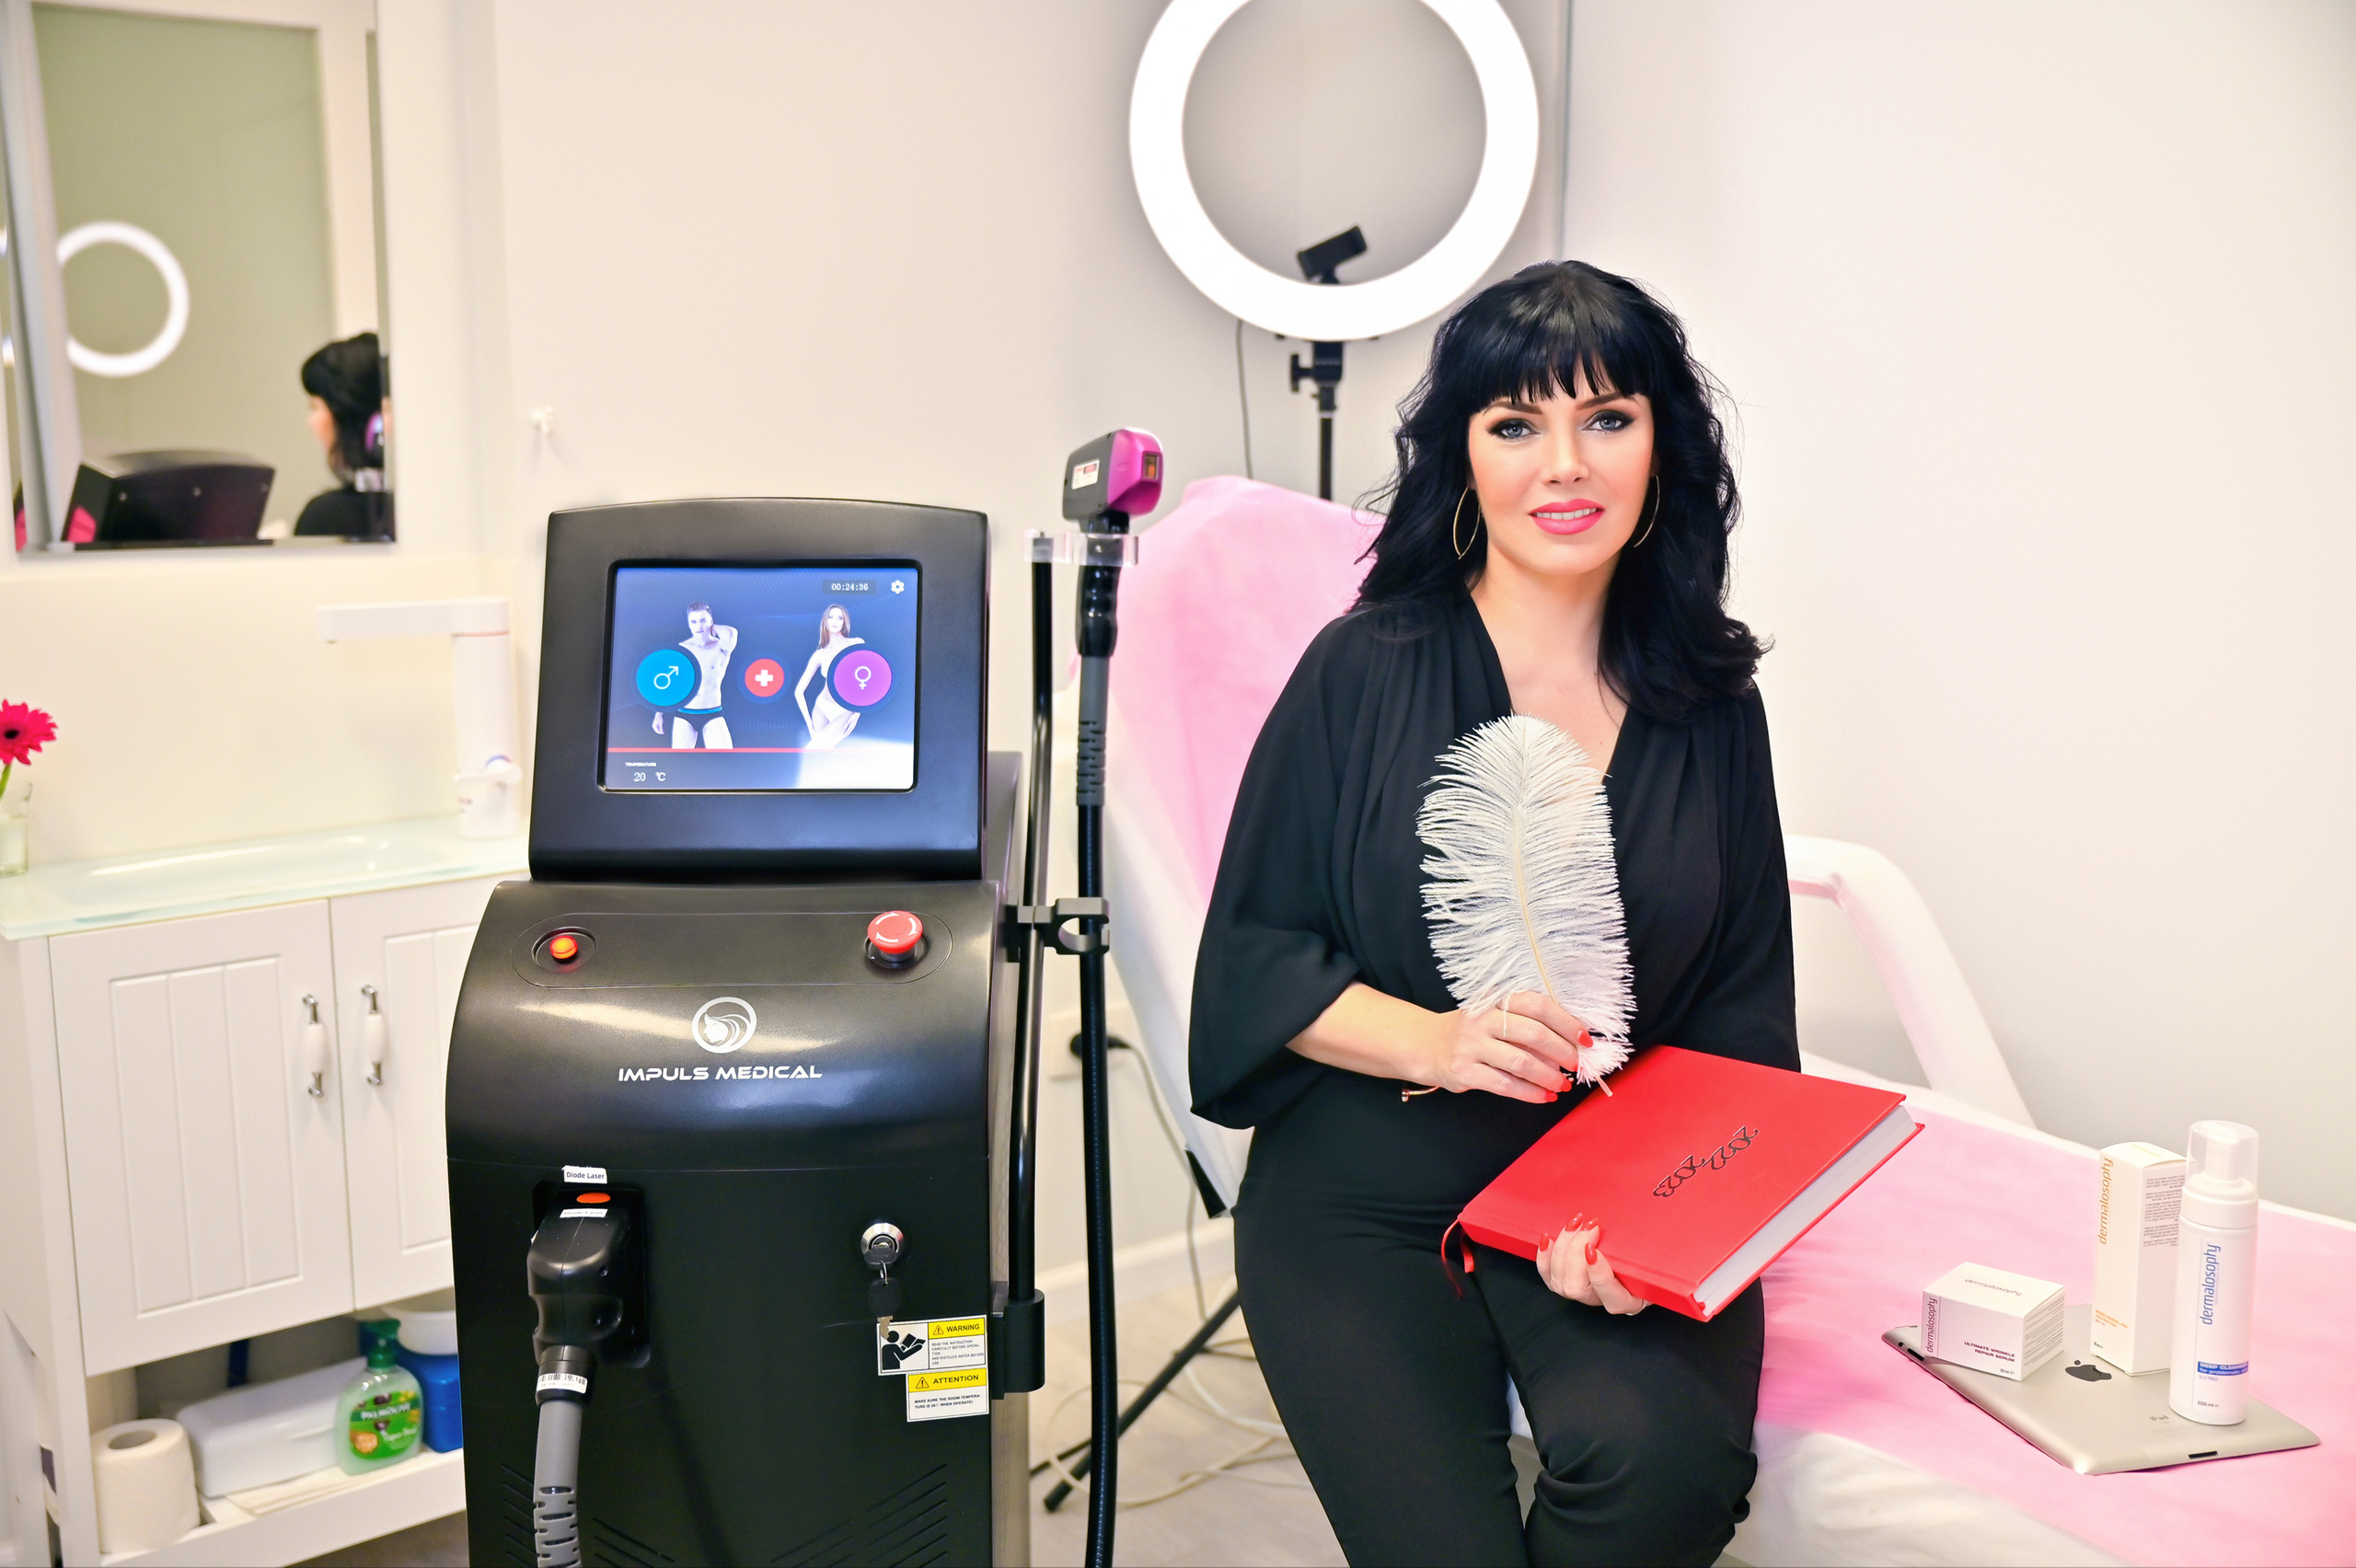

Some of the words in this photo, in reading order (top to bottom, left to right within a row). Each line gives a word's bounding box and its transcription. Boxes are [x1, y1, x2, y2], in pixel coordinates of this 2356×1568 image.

[831, 582, 869, 591] 00:24:36
[634, 771, 646, 782] 20
[618, 1066, 709, 1082] IMPULS
[715, 1065, 824, 1079] MEDICAL
[1702, 1125, 1759, 1170] 2022
[1653, 1154, 1705, 1197] 2023
[2097, 1158, 2114, 1245] dermalosophy
[1964, 1278, 2023, 1297] dermalosophy
[2200, 1244, 2222, 1325] dermalosophy
[947, 1323, 980, 1332] WARNING
[1925, 1297, 1937, 1354] dermalosophy
[1964, 1341, 1990, 1352] ULTIMATE
[1991, 1348, 2015, 1358] WRINKLE
[1974, 1349, 1994, 1357] REPAIR
[1995, 1354, 2015, 1363] SERUM
[933, 1375, 979, 1384] ATTENTION
